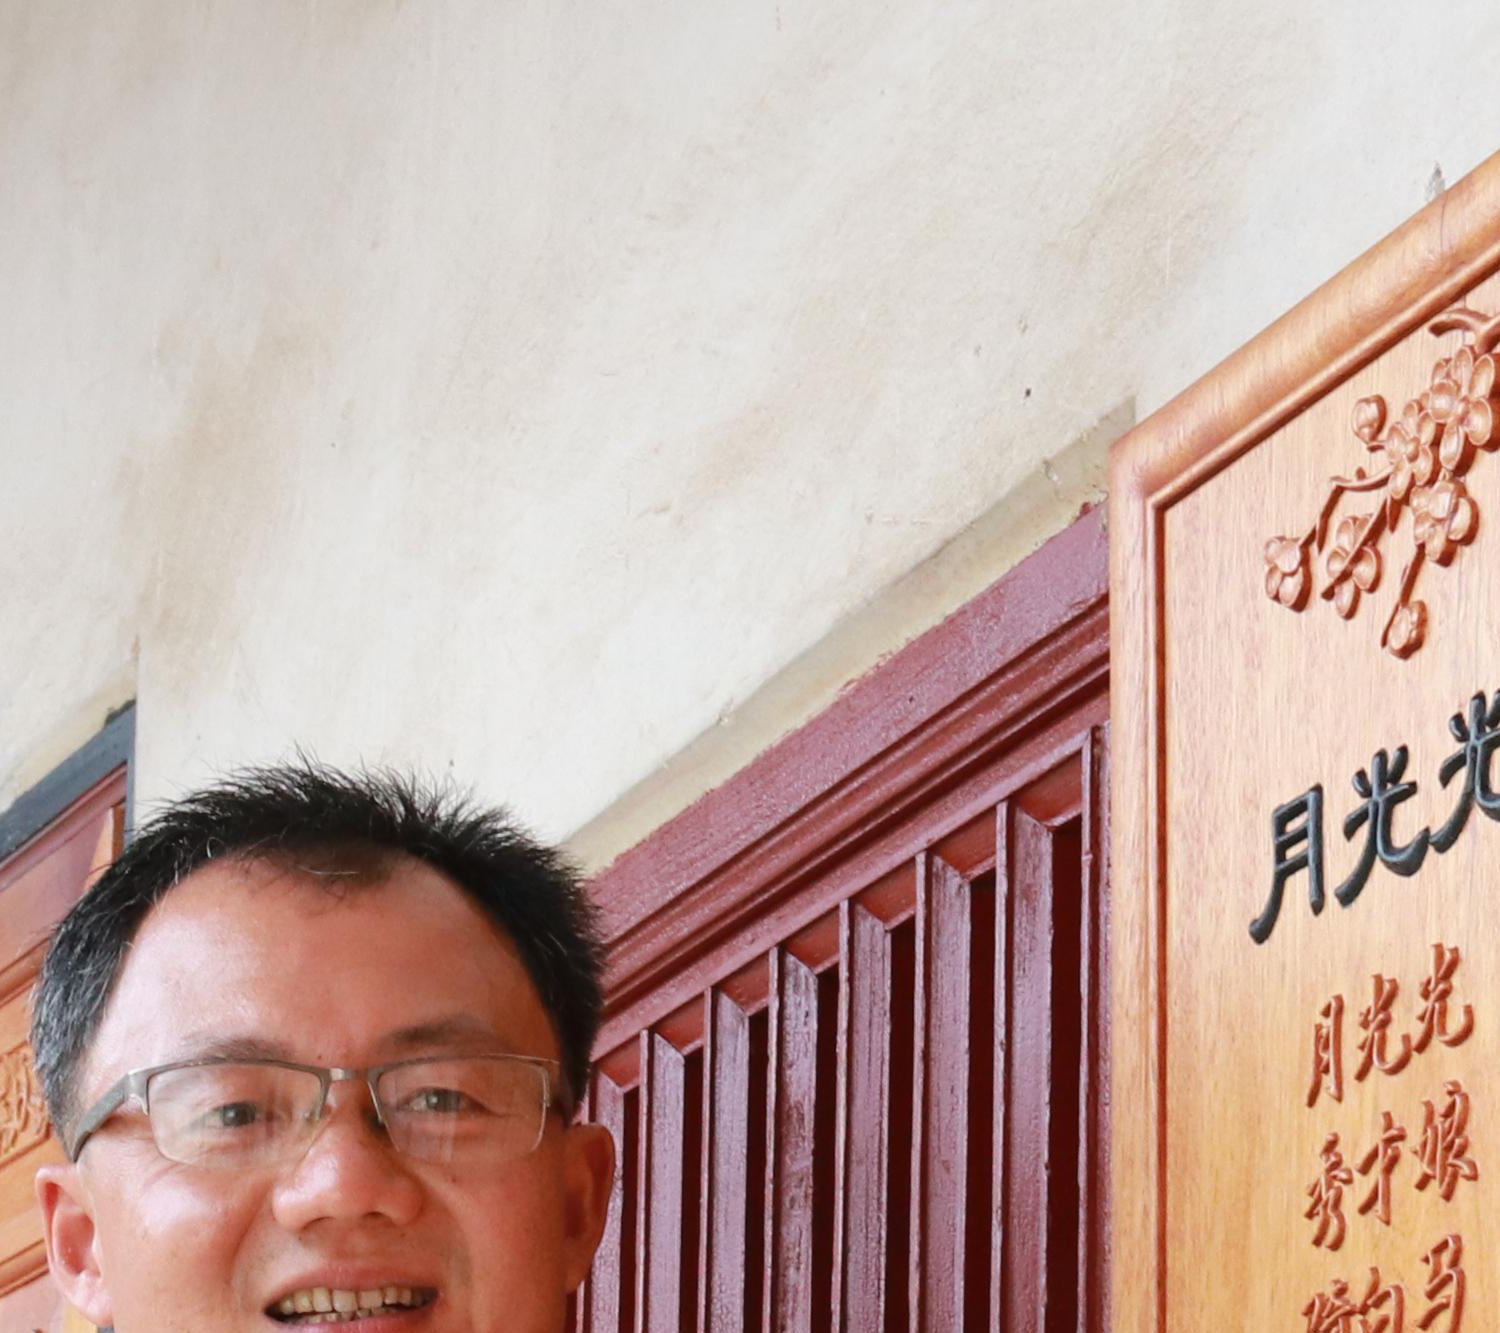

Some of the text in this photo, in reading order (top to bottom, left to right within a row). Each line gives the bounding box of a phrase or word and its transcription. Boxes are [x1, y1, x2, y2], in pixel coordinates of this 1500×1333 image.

[1306, 942, 1475, 1109] 月光光
[1303, 1079, 1479, 1252] 秀才娘
